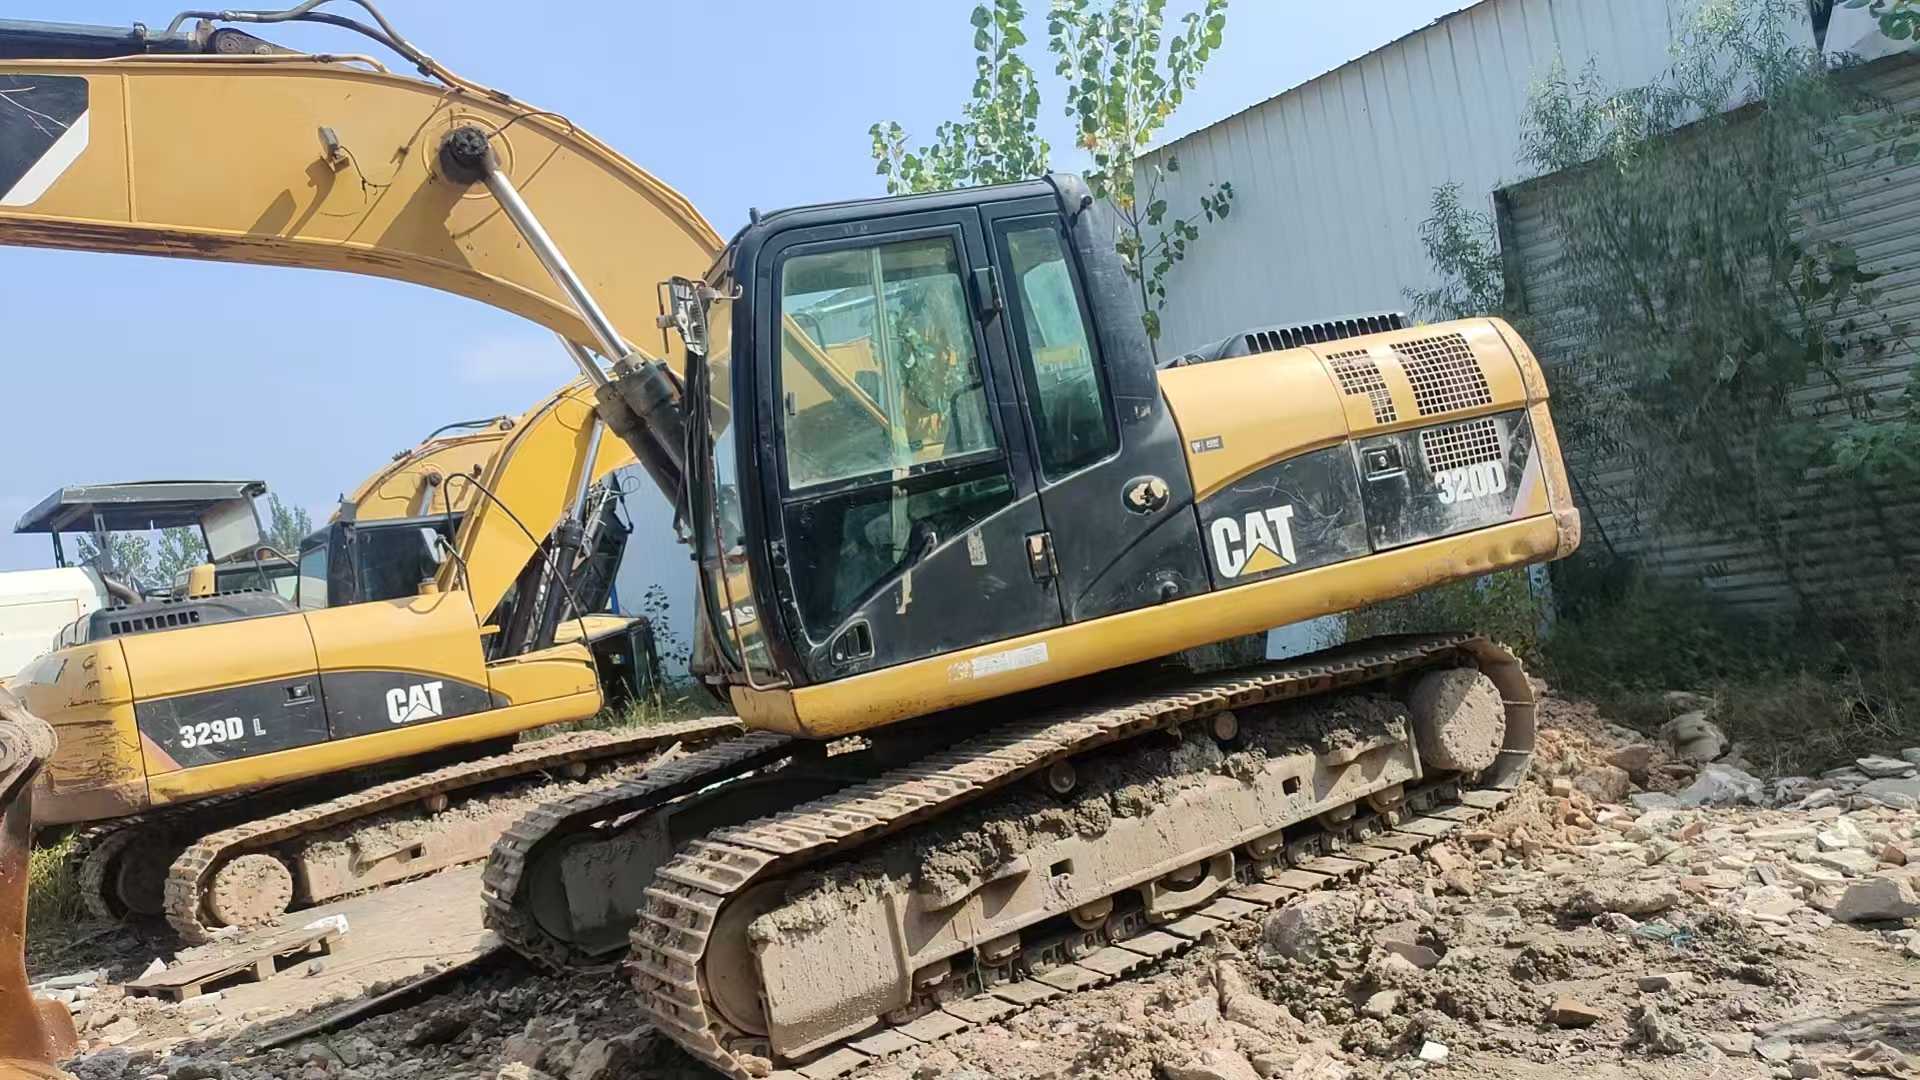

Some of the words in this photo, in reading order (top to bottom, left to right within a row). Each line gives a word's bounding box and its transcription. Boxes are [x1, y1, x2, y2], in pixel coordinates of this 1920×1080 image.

[1435, 462, 1507, 504] 320D
[1210, 505, 1296, 577] CAT
[386, 682, 443, 723] CAT
[179, 717, 244, 748] 329D
[253, 718, 266, 736] L
